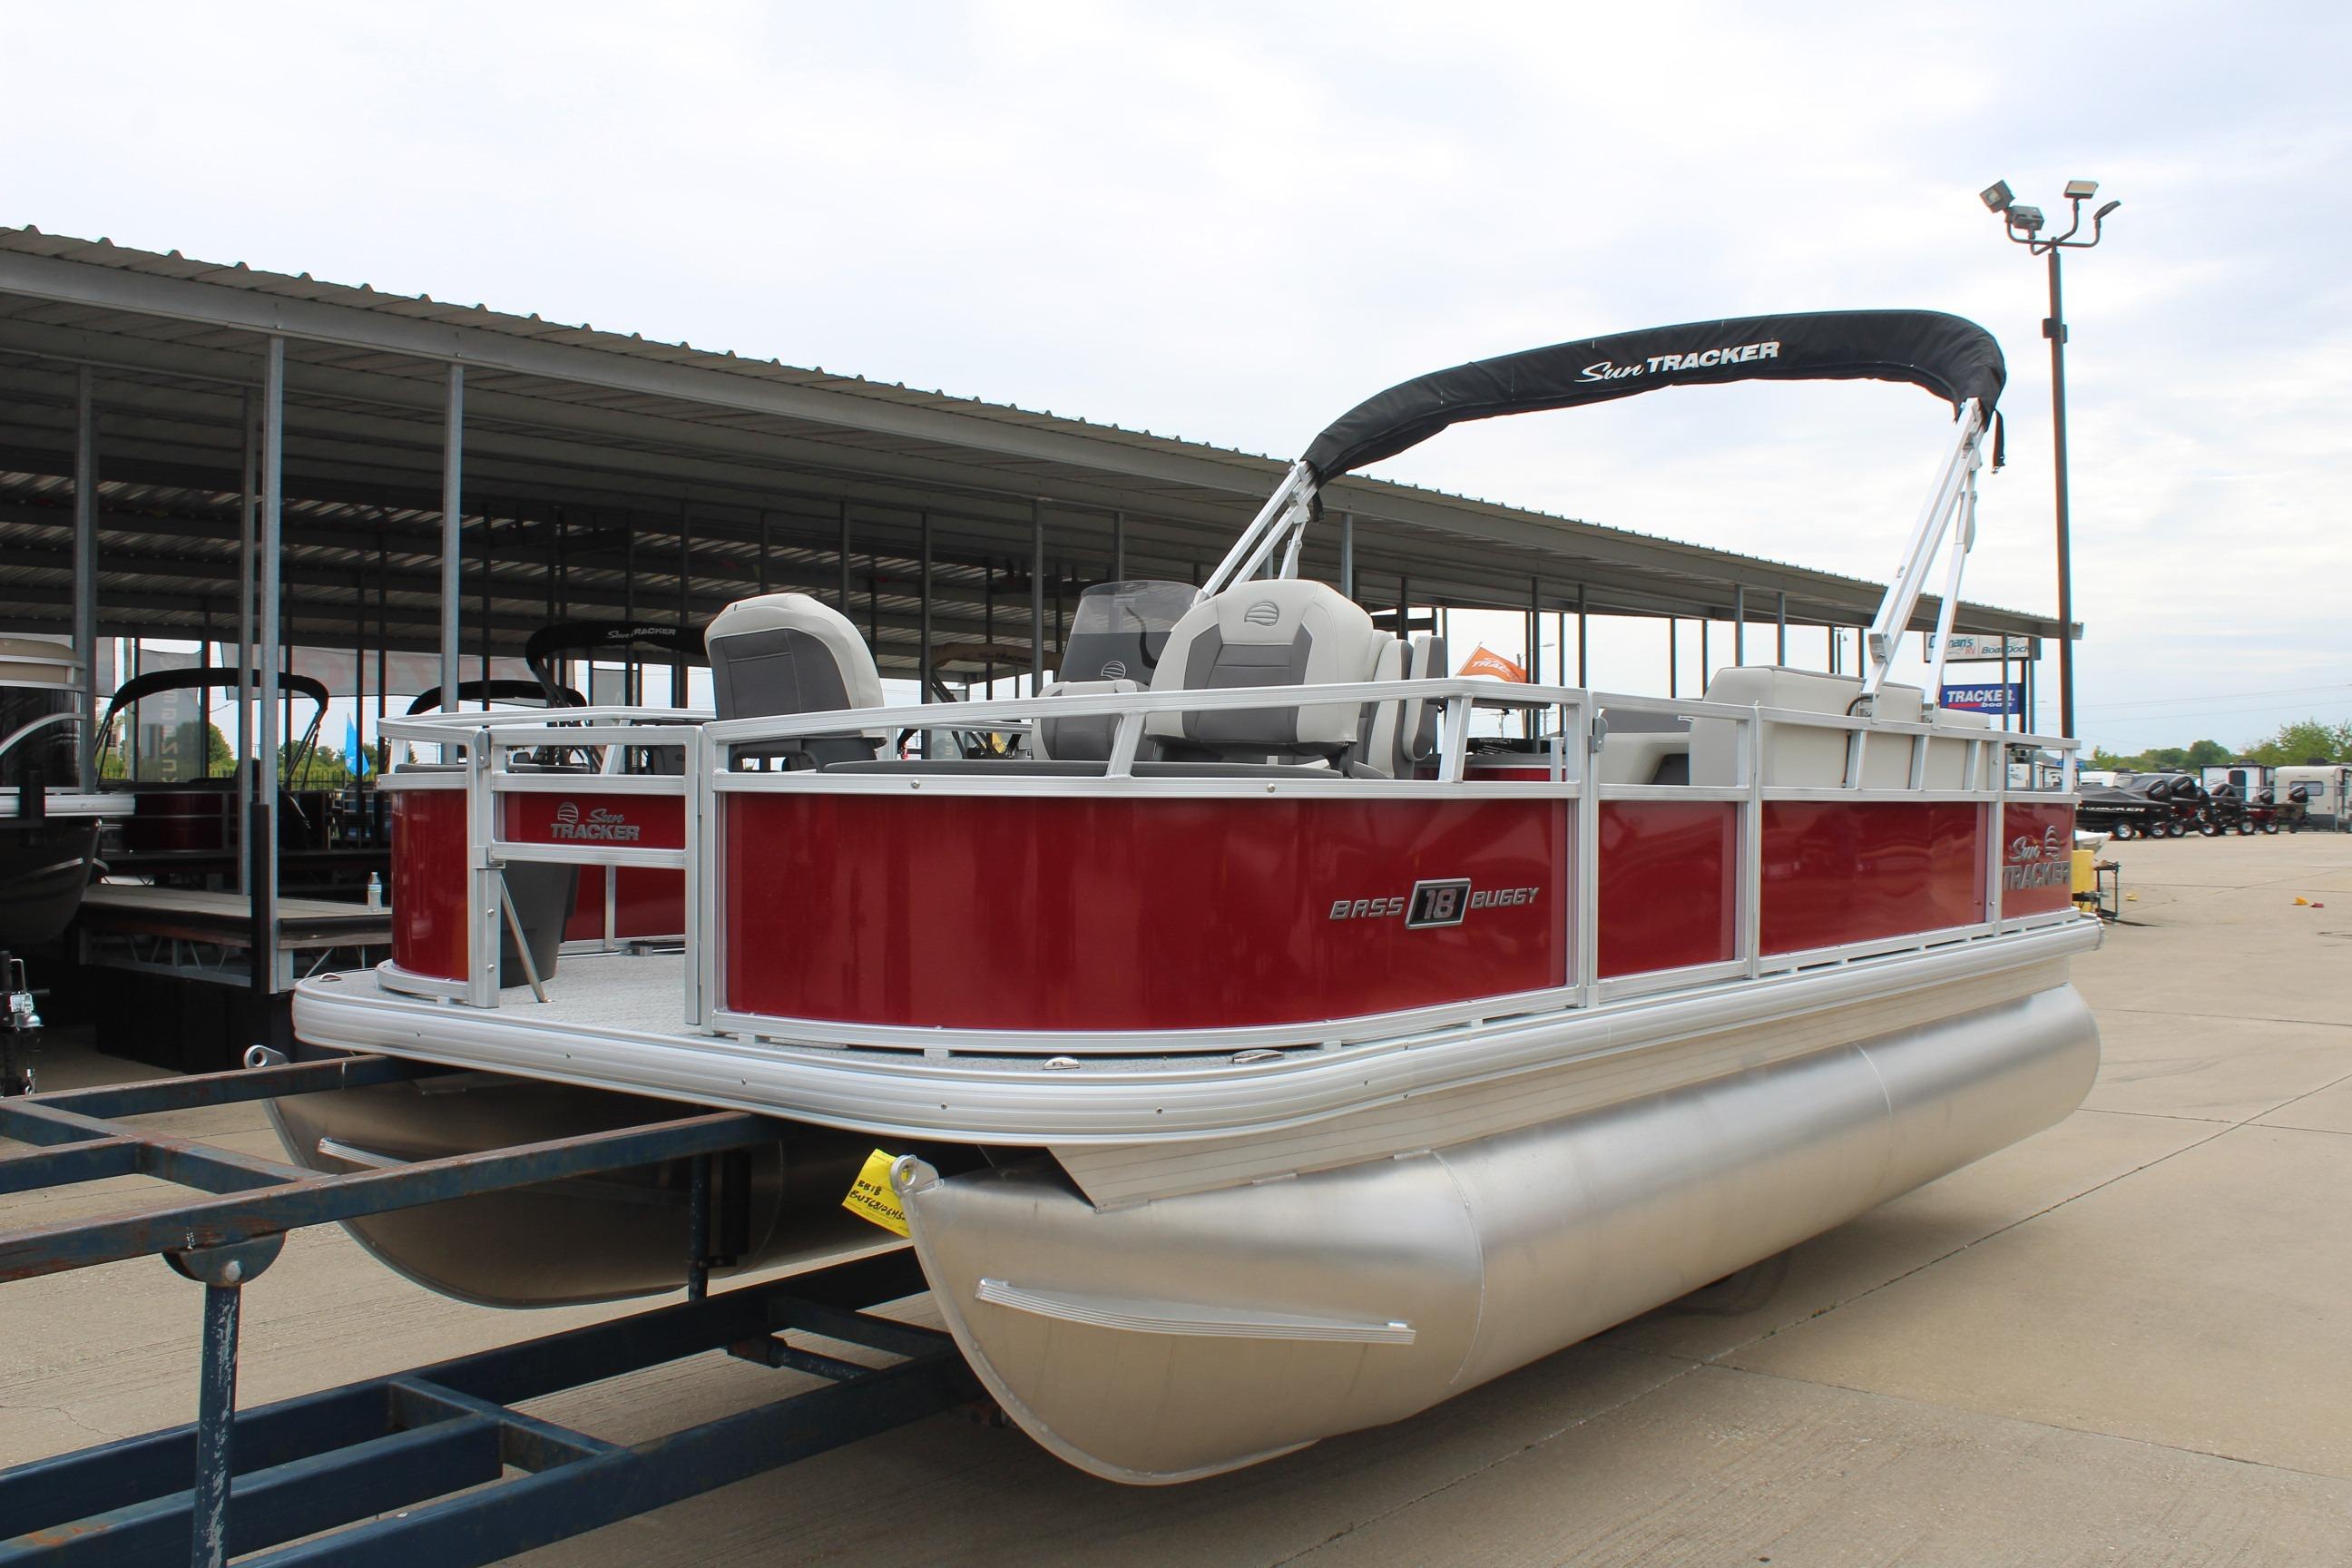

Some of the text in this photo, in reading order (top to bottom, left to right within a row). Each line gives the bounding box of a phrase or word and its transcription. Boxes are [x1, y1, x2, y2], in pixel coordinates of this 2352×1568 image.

[1574, 341, 1780, 383] Sun TRACKER
[586, 808, 625, 824] Sun
[550, 823, 640, 841] TRACKER
[2008, 836, 2041, 863] Sun
[2003, 860, 2072, 891] TRACKER
[1329, 887, 1539, 920] BASS 18 BUGGY
